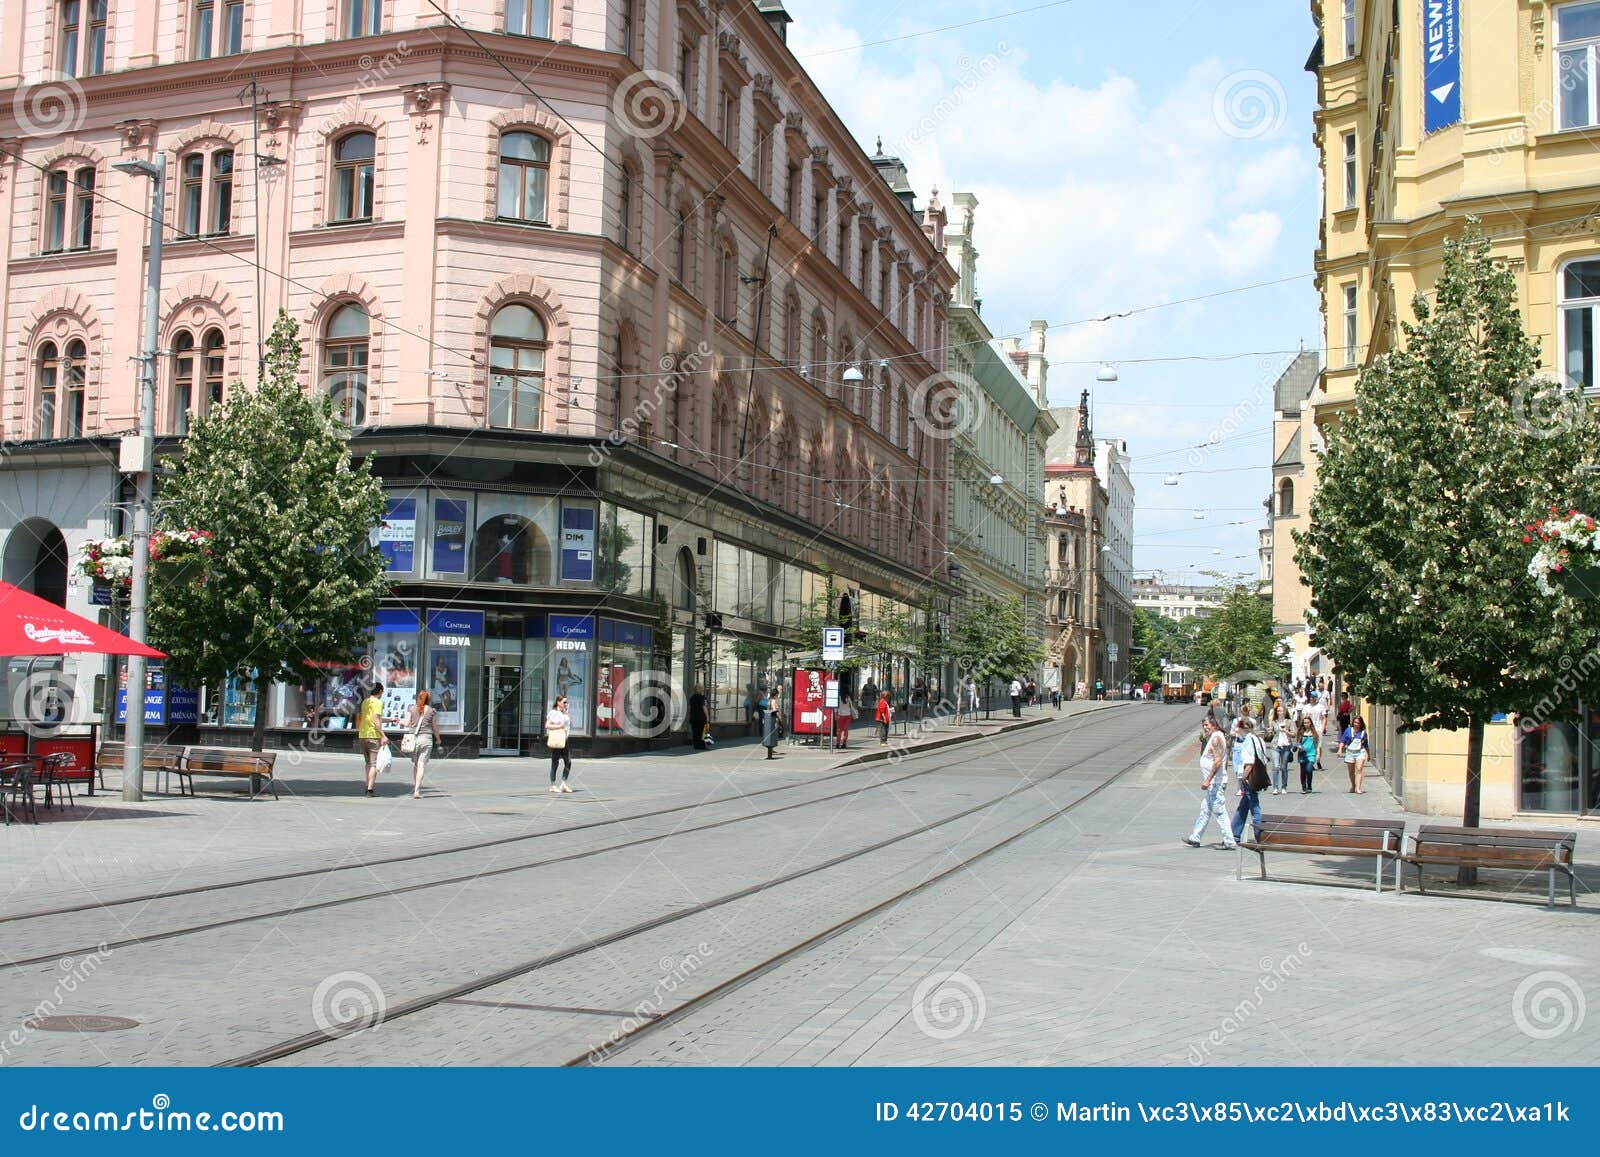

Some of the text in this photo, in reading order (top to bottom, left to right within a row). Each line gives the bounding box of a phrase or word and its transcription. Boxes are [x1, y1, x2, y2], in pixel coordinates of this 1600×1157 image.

[1428, 0, 1443, 63] NEW
[565, 533, 583, 541] DIM
[439, 636, 471, 647] HEDVA
[556, 640, 587, 651] HEDVA
